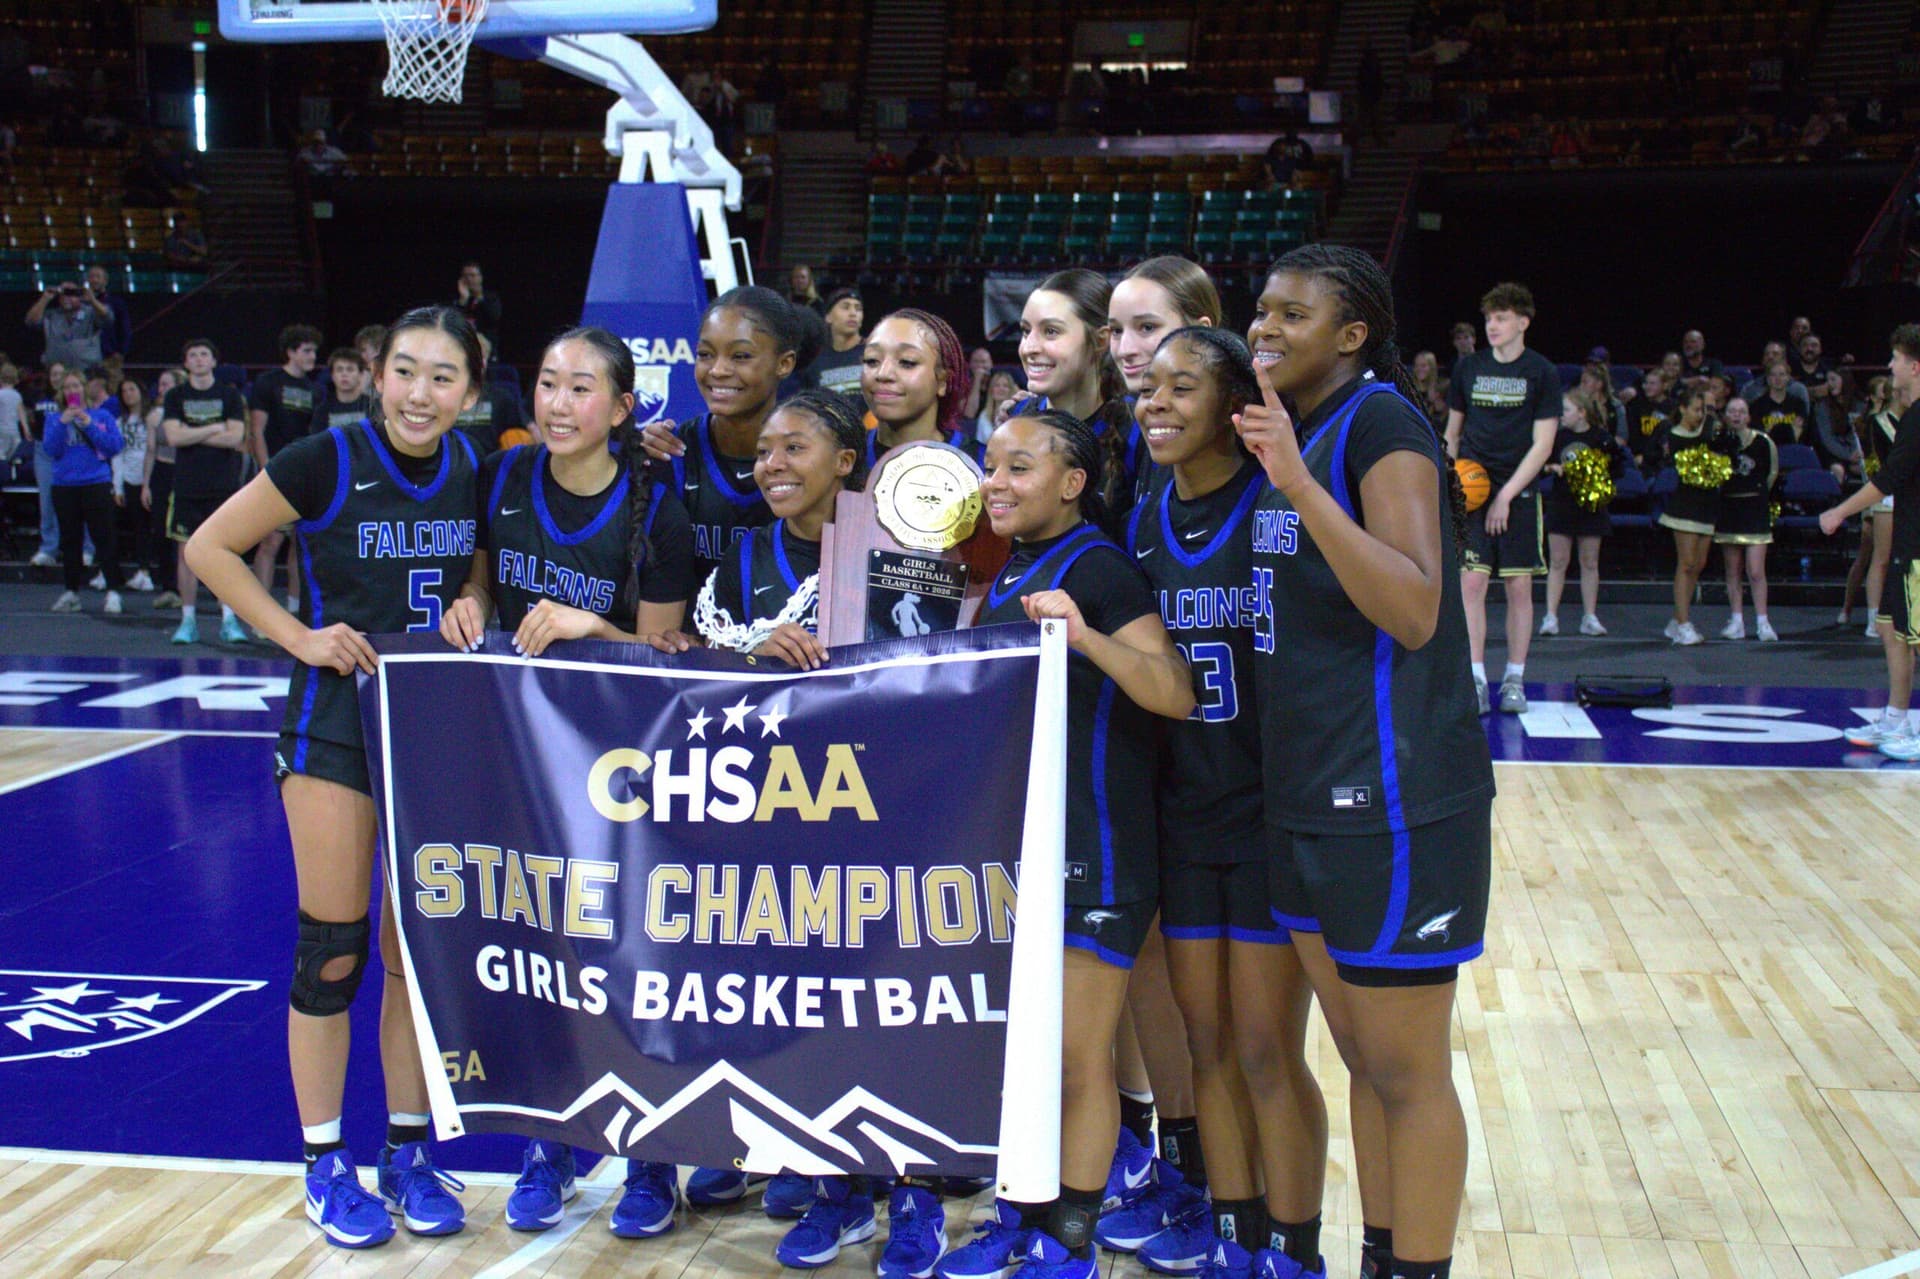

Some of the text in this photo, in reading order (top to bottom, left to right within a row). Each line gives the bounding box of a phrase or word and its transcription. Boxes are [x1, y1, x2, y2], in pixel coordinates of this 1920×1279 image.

[622, 338, 696, 365] SAA
[1473, 376, 1527, 393] JAGUARS
[358, 519, 477, 558] FALCONS
[499, 548, 616, 614] FALCONS
[882, 563, 954, 584] BASKETBALL
[902, 558, 937, 571] GIRLS
[406, 568, 443, 633] 5
[881, 578, 952, 596] CLASS 6A 2026
[1160, 587, 1257, 630] LCONS
[1176, 641, 1239, 723] 3
[1518, 700, 1920, 743] IS
[587, 744, 880, 823] CHSAA
[1355, 792, 1368, 802] XL
[1073, 867, 1083, 878] M
[414, 843, 1023, 948] STATE CHAMPION
[476, 944, 1008, 1028] GIRLS BASKETBAL
